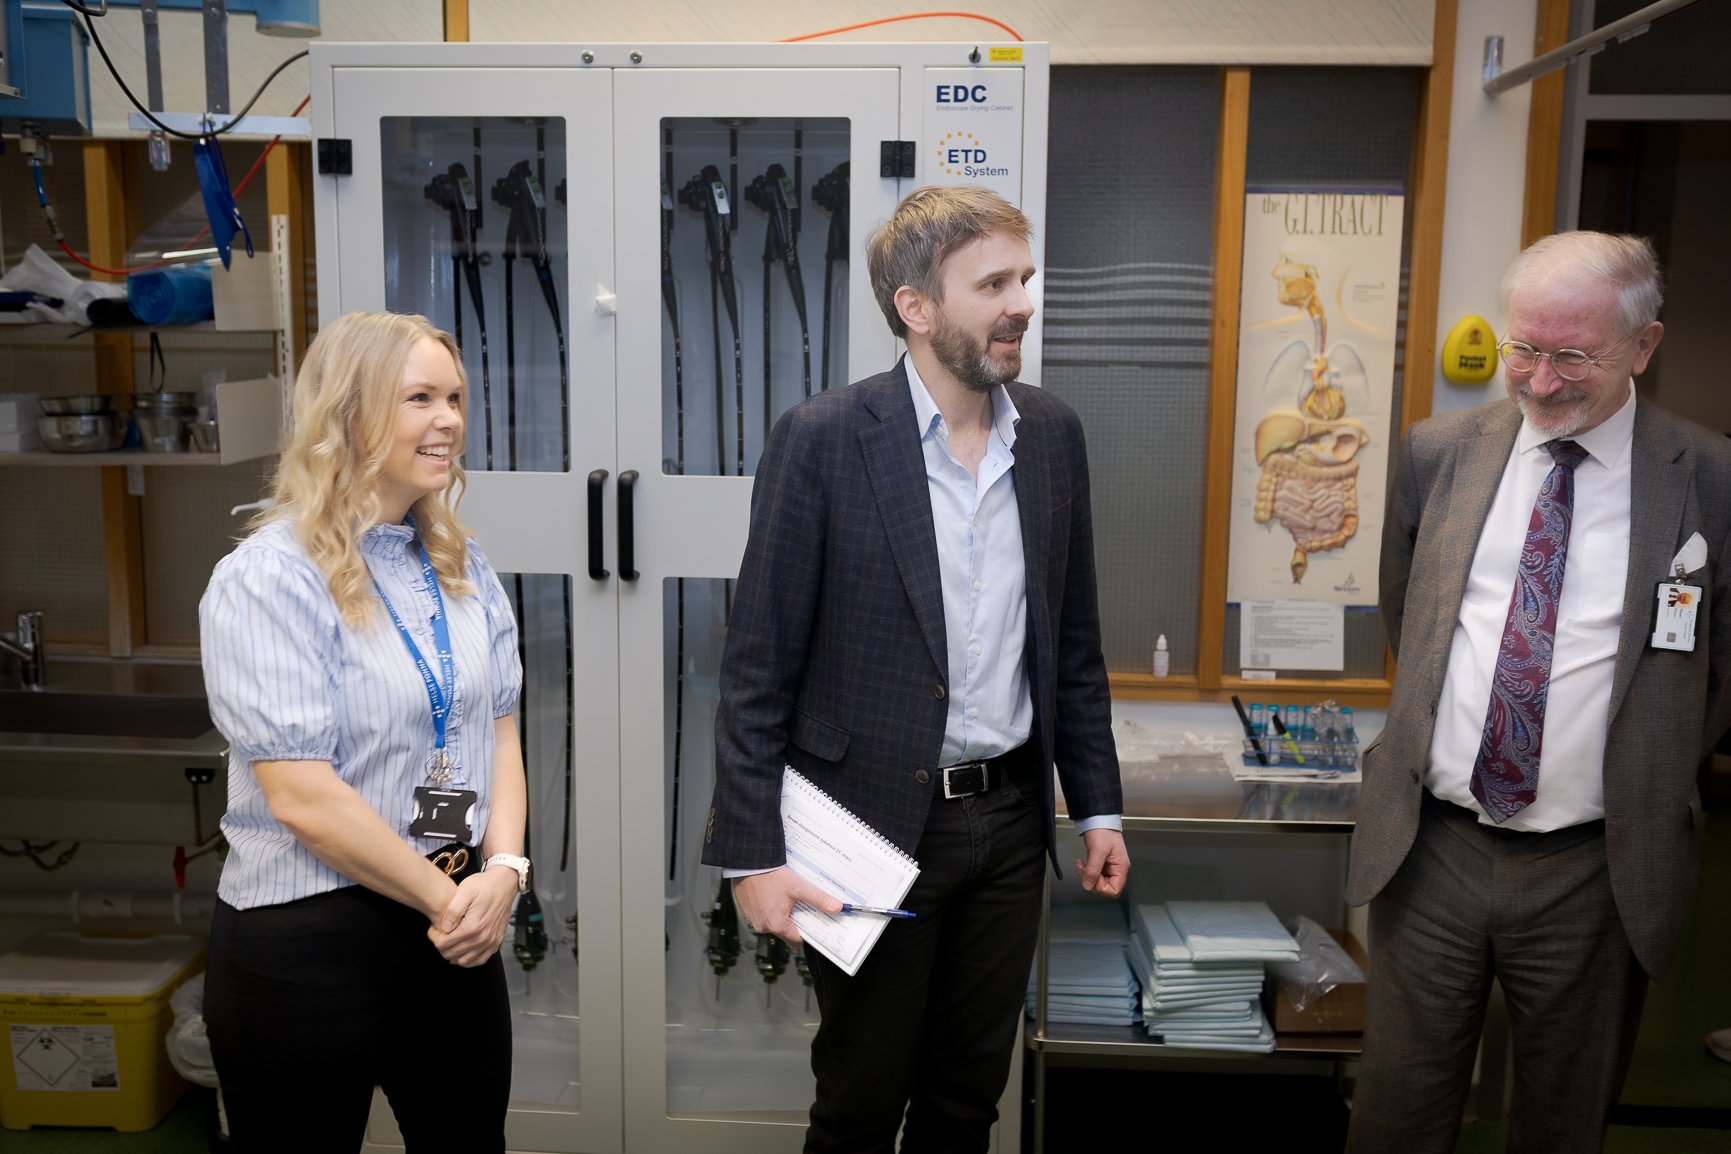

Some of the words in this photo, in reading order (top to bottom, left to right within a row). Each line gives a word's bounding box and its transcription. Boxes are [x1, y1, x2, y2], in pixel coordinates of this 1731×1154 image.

[936, 84, 987, 103] EDC
[948, 149, 987, 164] ETD
[964, 166, 1009, 178] System
[1262, 193, 1281, 214] the
[427, 576, 438, 596] HELSE
[417, 659, 433, 684] FONNA
[444, 664, 453, 683] HELSE
[428, 683, 439, 704] HELSE
[445, 684, 453, 710] FONNA
